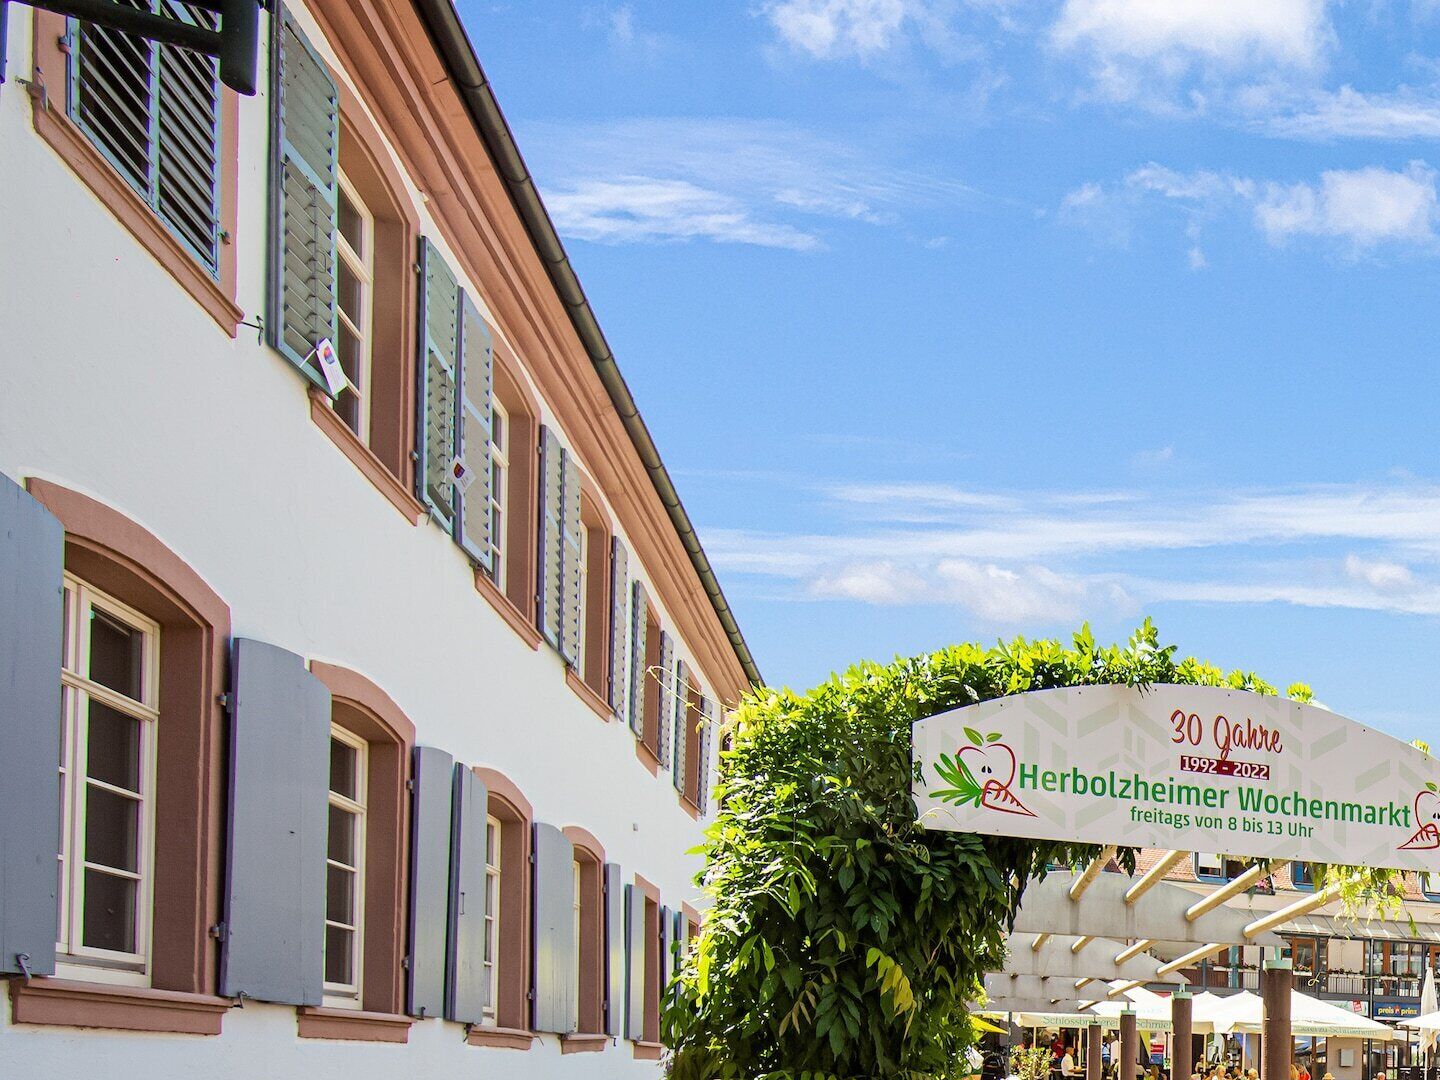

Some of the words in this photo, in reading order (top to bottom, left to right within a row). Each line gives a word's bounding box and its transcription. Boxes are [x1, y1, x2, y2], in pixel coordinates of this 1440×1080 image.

[1170, 709, 1202, 746] 30
[1213, 715, 1283, 761] Jahre
[1182, 756, 1218, 774] 1992
[1233, 762, 1268, 780] 2022
[1019, 763, 1230, 808] Herbolzheimer
[1238, 786, 1411, 828] Wochenmarkt
[1130, 806, 1190, 829] freitags
[1194, 815, 1223, 830] von
[1228, 817, 1238, 831] 8
[1243, 817, 1263, 833] bis
[1267, 820, 1283, 835] 13
[1288, 822, 1314, 838] Uhr
[1043, 1016, 1119, 1027] Schlossbrerei
[1378, 1006, 1395, 1016] preis
[1401, 1006, 1418, 1016] prinz
